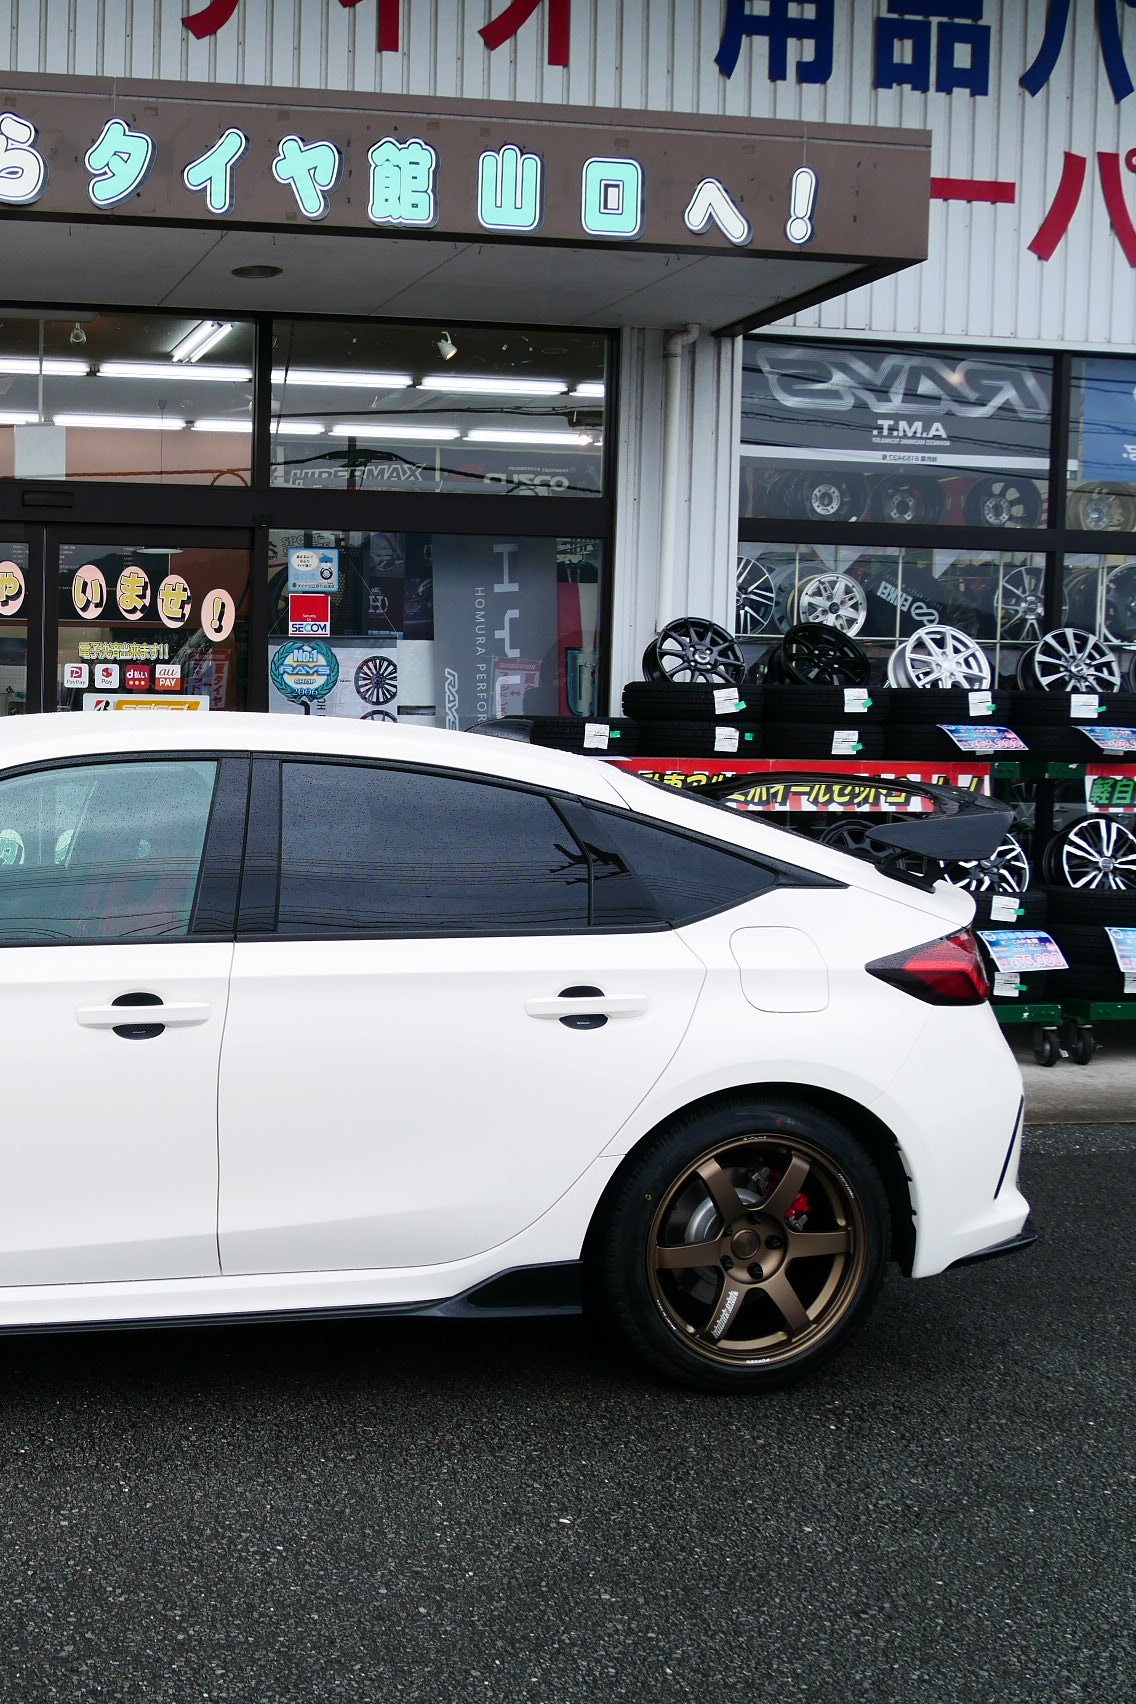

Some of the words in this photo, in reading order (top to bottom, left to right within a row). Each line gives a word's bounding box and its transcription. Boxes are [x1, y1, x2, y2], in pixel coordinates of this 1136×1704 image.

[474, 587, 487, 656] HOMURA
[291, 623, 327, 633] SECOM
[293, 649, 319, 662] No.1
[279, 664, 331, 675] RAYS
[67, 678, 86, 686] PayPay
[101, 678, 113, 687] Pay
[159, 678, 177, 687] PAY
[293, 688, 319, 696] 2006
